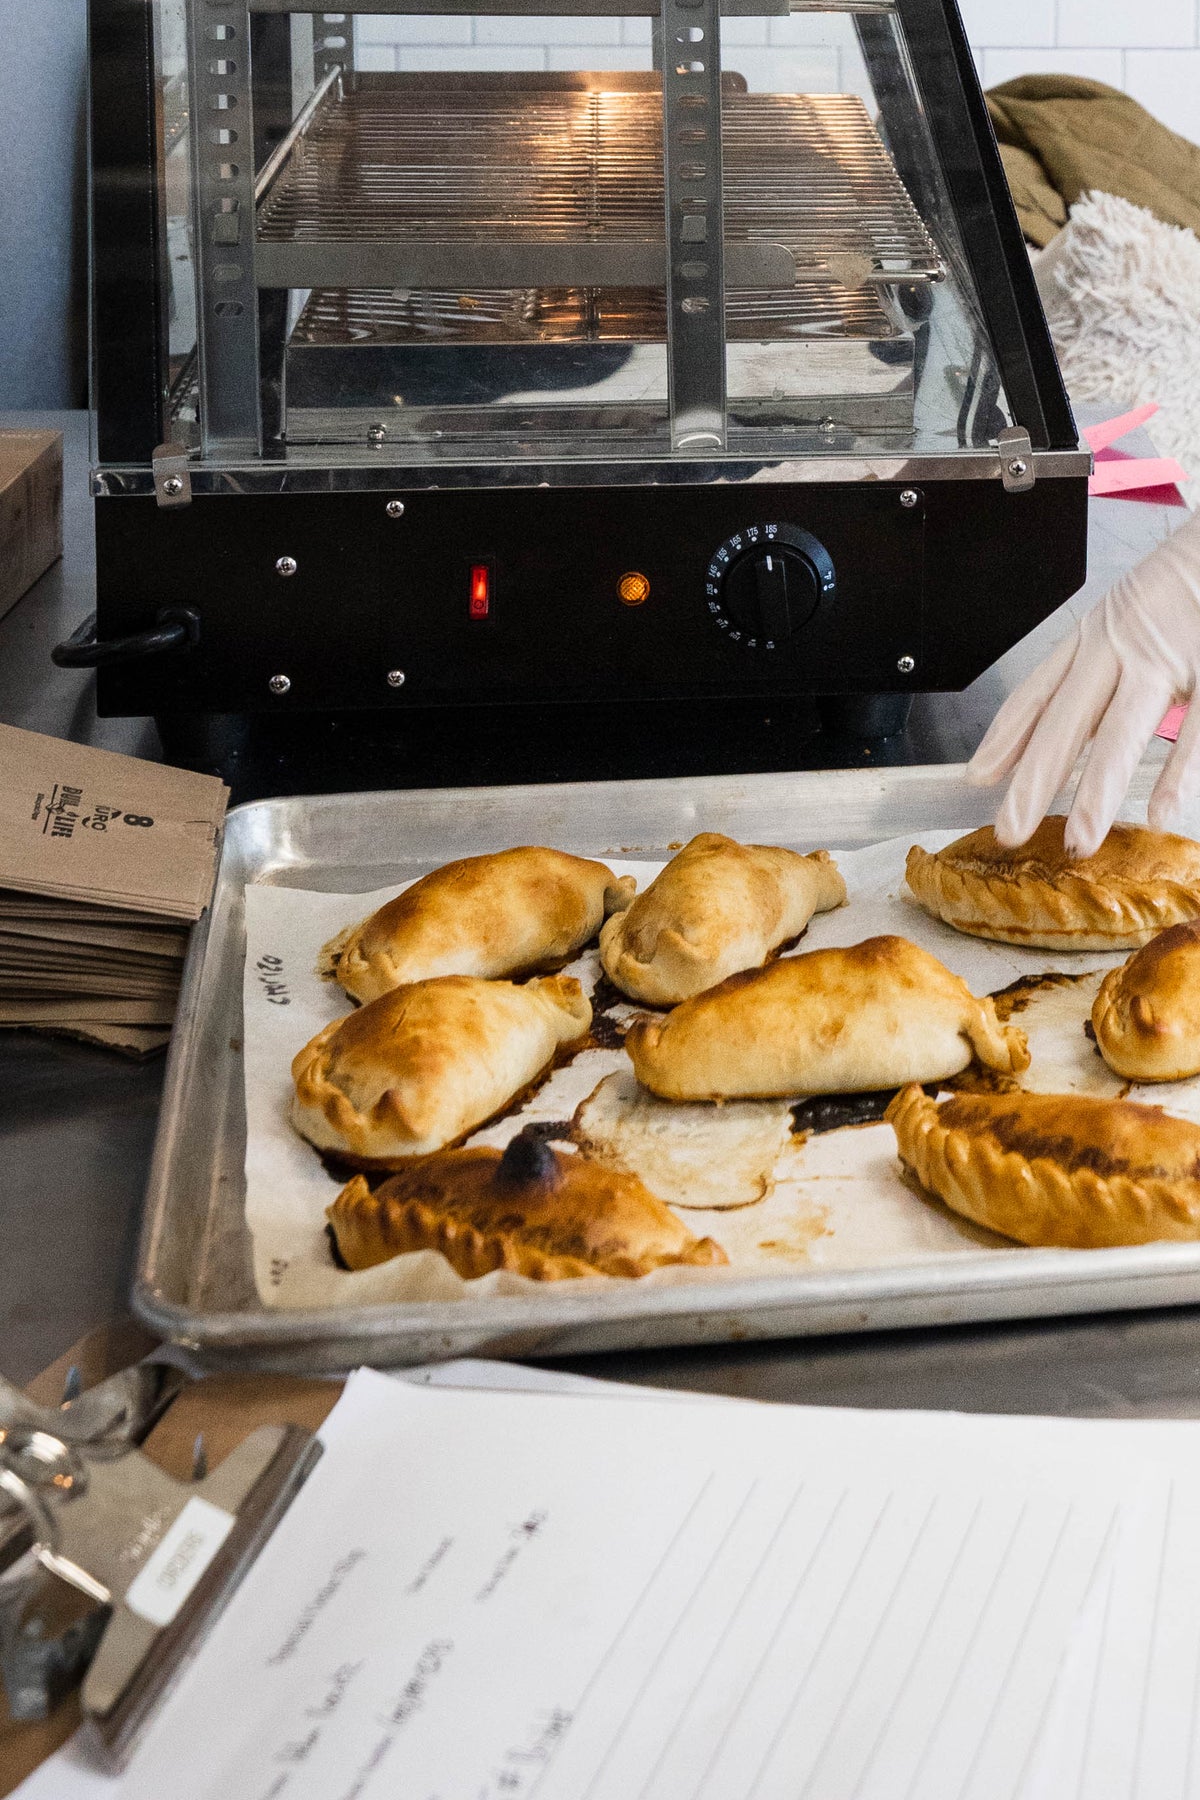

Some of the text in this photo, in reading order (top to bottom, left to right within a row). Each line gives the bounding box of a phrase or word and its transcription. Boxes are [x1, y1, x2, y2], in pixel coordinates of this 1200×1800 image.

[708, 564, 718, 578] 145
[716, 547, 728, 561] 155
[729, 534, 742, 547] 165
[746, 526, 759, 537] 175
[765, 524, 778, 534] 185
[123, 813, 155, 828] 8
